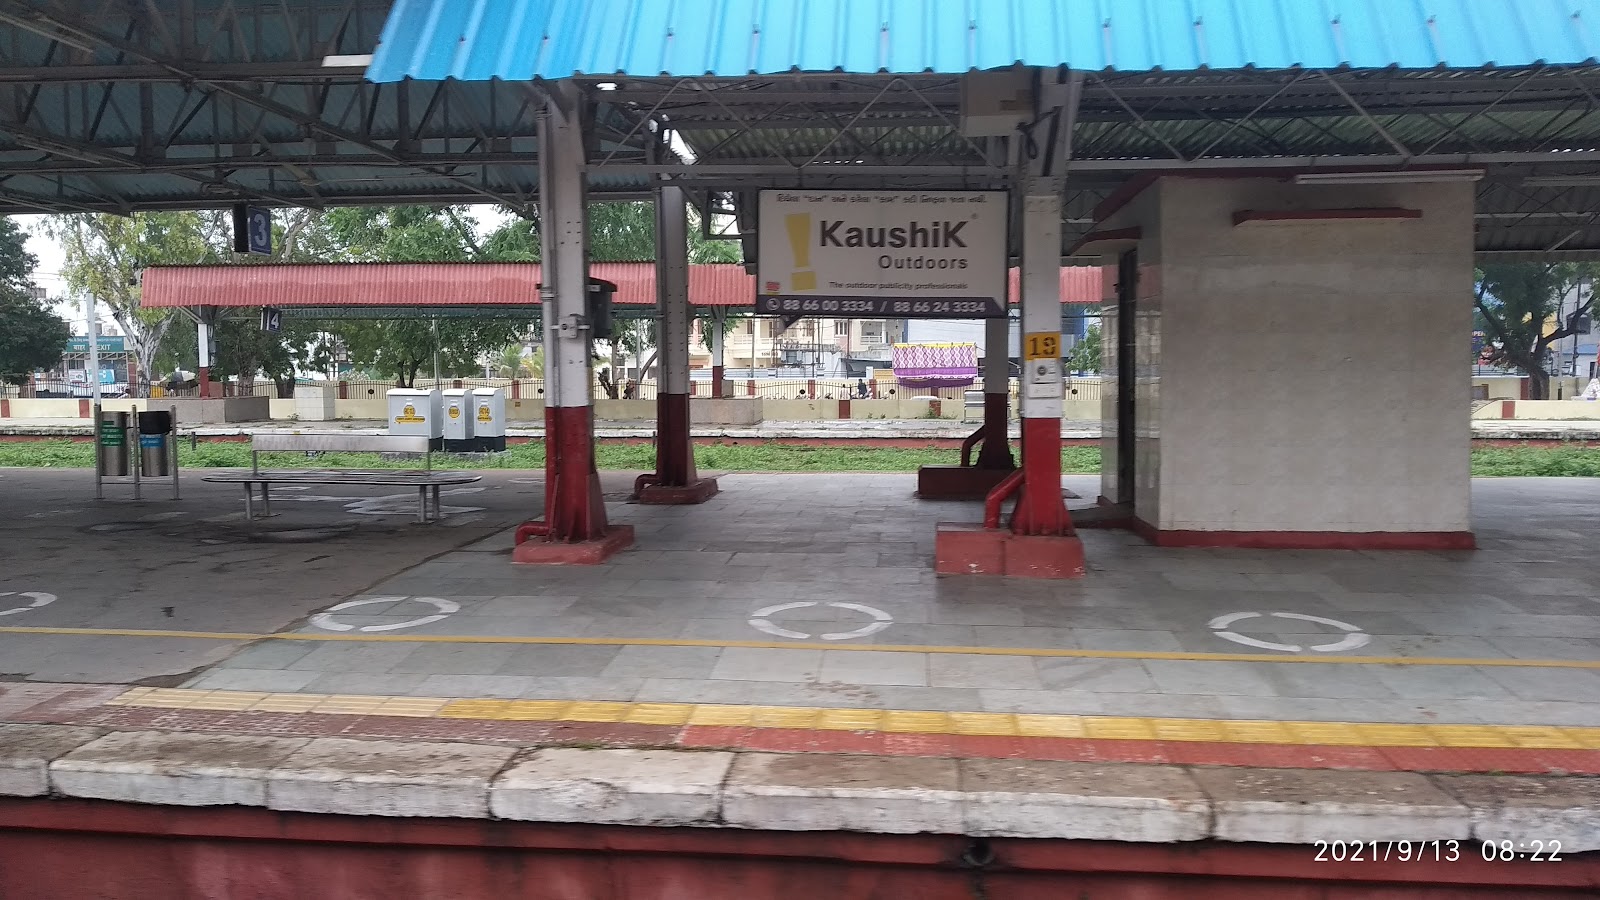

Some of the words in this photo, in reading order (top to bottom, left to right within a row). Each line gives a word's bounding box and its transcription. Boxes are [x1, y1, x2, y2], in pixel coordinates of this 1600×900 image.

[254, 213, 267, 246] 3
[820, 220, 969, 248] KaushiK
[878, 255, 968, 270] Outdoors
[829, 281, 844, 289] The
[878, 282, 913, 291] publicity
[914, 282, 969, 291] professionals
[783, 299, 801, 311] 88
[803, 299, 819, 311] 66
[822, 300, 839, 311] 00
[841, 300, 875, 312] 3334
[893, 301, 912, 313] 88
[913, 302, 931, 313] 66
[932, 302, 951, 313] 24
[952, 302, 987, 313] 3334
[270, 312, 279, 328] 4
